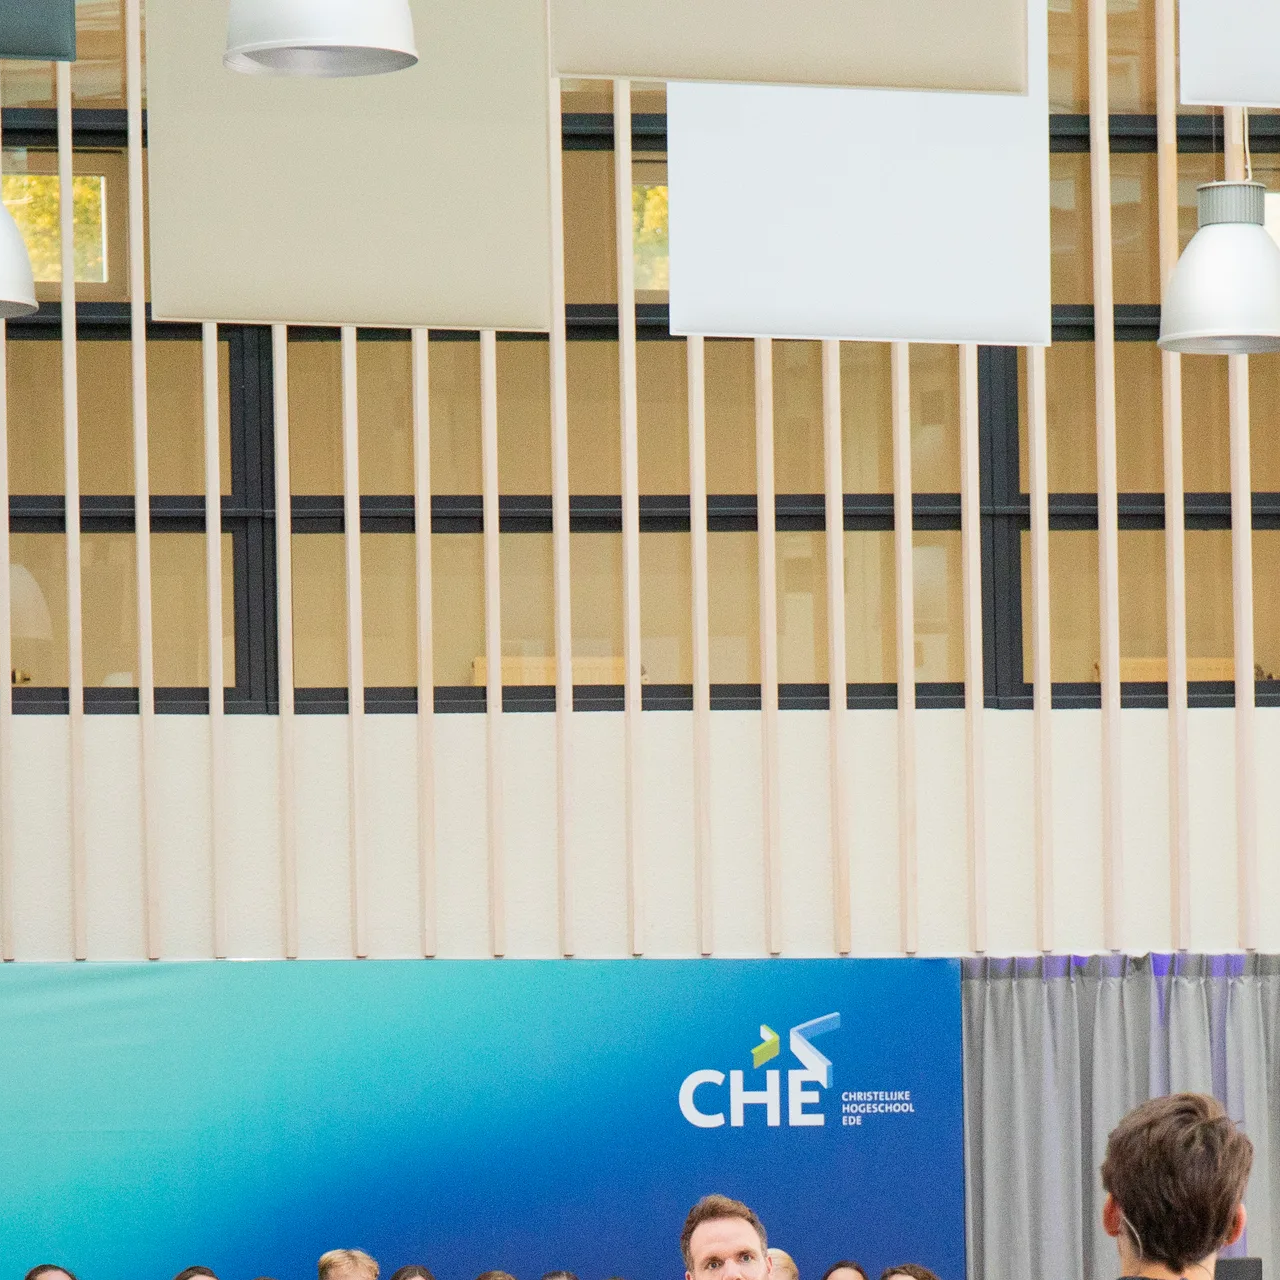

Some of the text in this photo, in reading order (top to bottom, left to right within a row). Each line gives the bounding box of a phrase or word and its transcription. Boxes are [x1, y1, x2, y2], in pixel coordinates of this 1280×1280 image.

[678, 1069, 826, 1128] CHE
[841, 1091, 911, 1102] CHRISTELIJKE
[842, 1103, 915, 1114] HOGESCHOOL
[842, 1115, 862, 1126] EDE
